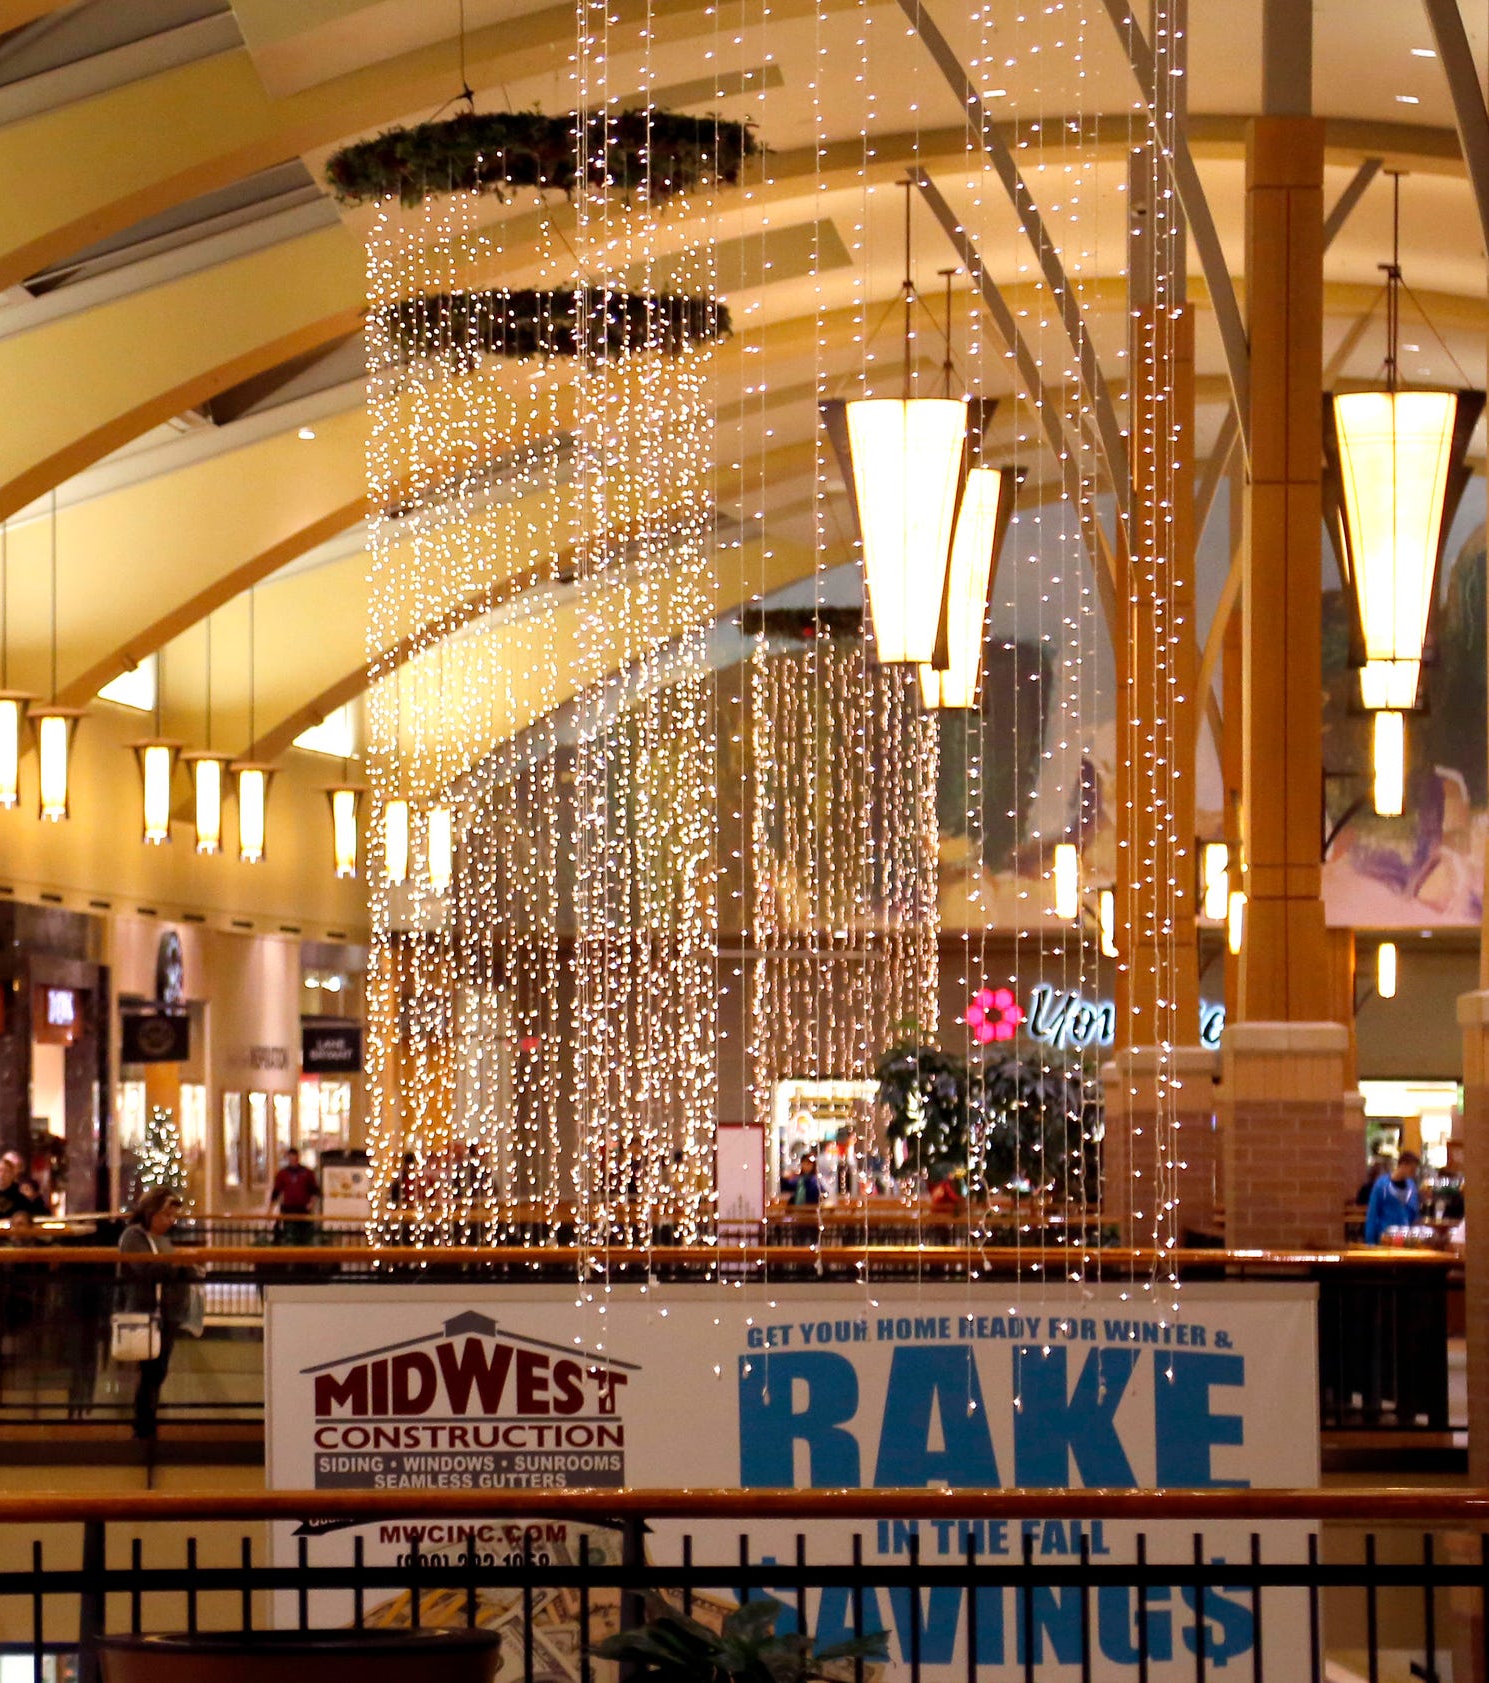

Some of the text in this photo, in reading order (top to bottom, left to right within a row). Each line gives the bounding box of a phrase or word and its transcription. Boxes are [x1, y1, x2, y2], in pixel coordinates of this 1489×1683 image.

[747, 1316, 1233, 1348] GET YOUR HOME READY FOR WINTER &
[314, 1337, 628, 1416] MIDWEST
[738, 1344, 1251, 1488] RAKE
[314, 1425, 625, 1449] CONSTRUCTION
[319, 1455, 621, 1472] SIDING WINDOWS SUNROOMS
[374, 1473, 567, 1489] SEAMLESS GUTTERS
[380, 1524, 567, 1544] MWCINC.COM
[876, 1520, 1110, 1555] IN THE FALL
